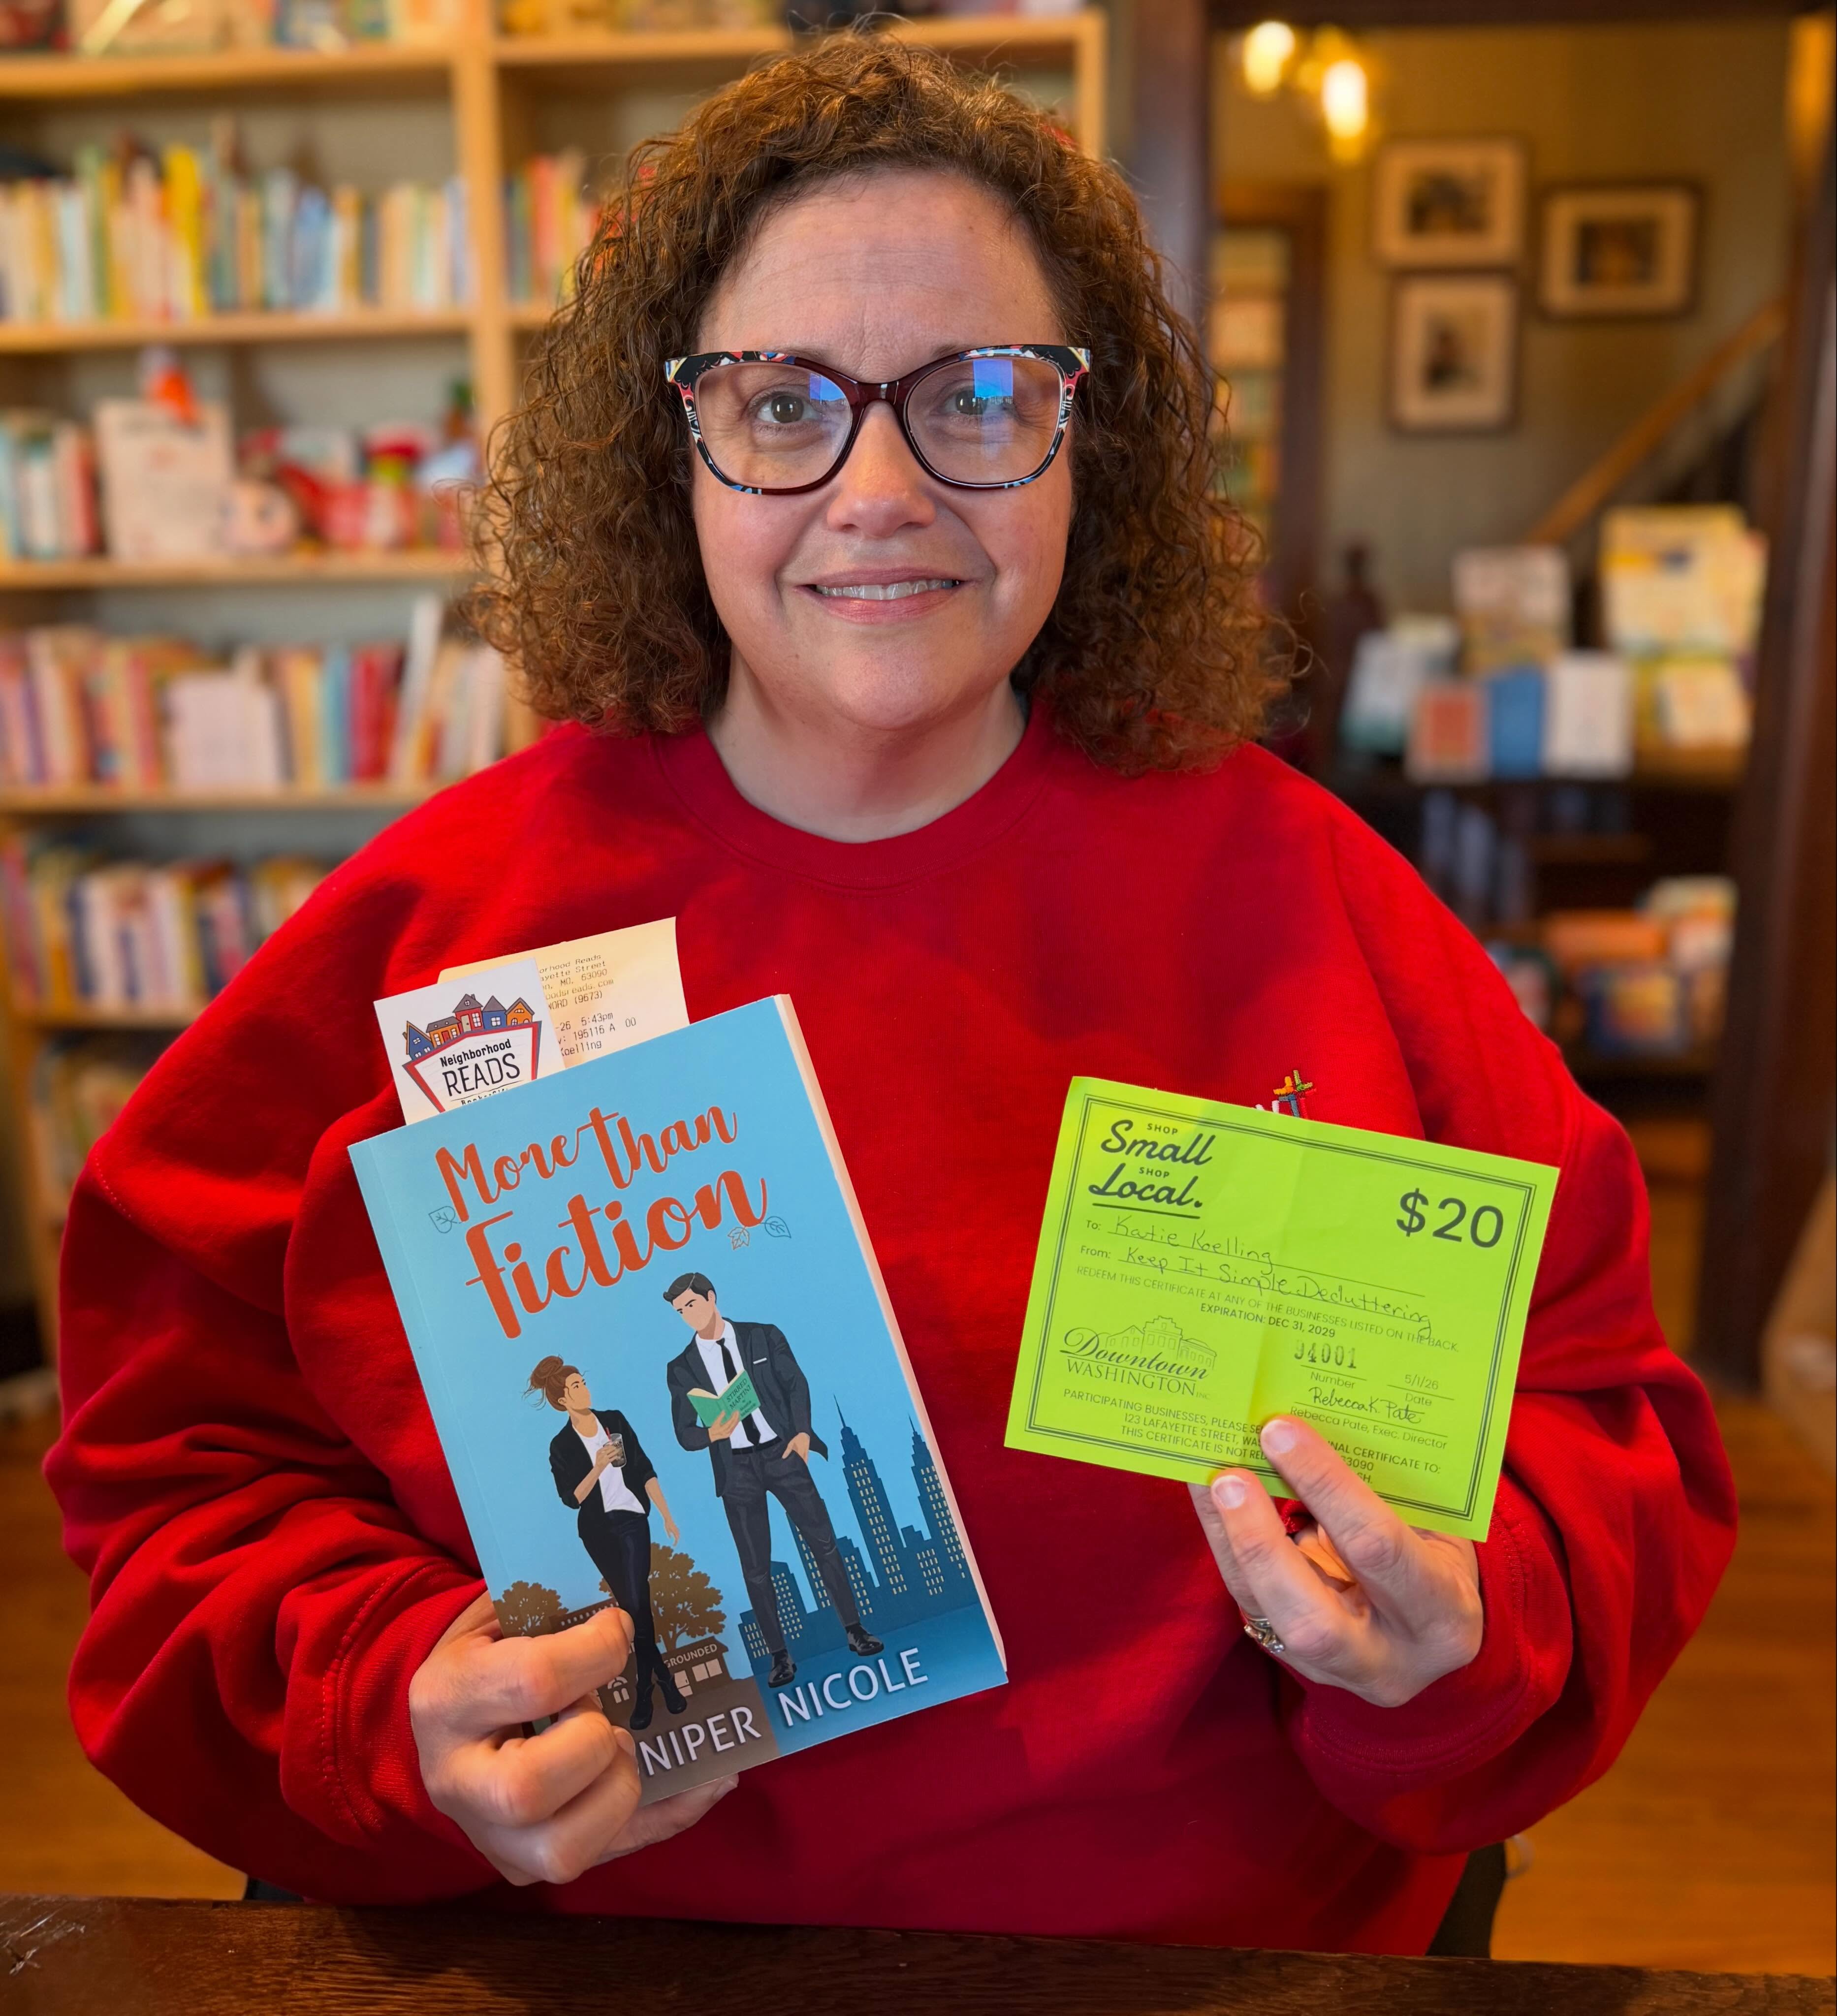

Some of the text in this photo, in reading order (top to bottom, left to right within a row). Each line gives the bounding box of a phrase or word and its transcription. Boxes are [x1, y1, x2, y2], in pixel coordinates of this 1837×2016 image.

[539, 954, 601, 973] orhood Reads
[541, 961, 605, 981] yette Street
[581, 969, 607, 981] 63090
[575, 991, 602, 1004] (9673)
[573, 1025, 604, 1040] 195116
[609, 1023, 615, 1032] A
[581, 1012, 613, 1026] 5:43pm
[440, 1039, 511, 1067] Neighborhood
[442, 1053, 520, 1097] READS
[1101, 1119, 1216, 1166] Small
[1146, 1123, 1178, 1135] SHOP
[435, 1105, 738, 1224] More than
[1139, 1166, 1170, 1178] SHOP
[1088, 1163, 1203, 1208] Local.
[1086, 1220, 1101, 1230] To:
[1396, 1188, 1504, 1248] $20
[465, 1169, 768, 1340] Fiction
[1080, 1245, 1110, 1259] From:
[1115, 1215, 1273, 1275] Katie Koelling
[1077, 1265, 1459, 1352] REDEEM THIS CERTIFICATE AT ANY OF THE BUSINESSES LISTED ON THE BACK.
[1127, 1247, 1431, 1340] Keep It Simple Decluttering
[1201, 1303, 1335, 1338] EXPIRATION: DEC 31, 2029
[1059, 1327, 1210, 1380] Downtown
[1067, 1358, 1196, 1396] WASHINGTON
[1311, 1371, 1356, 1388] Number
[1405, 1374, 1439, 1390] 5/1/26
[1064, 1388, 1263, 1433] PARTICIPATING BUSINESSES, PLEASE SE
[1405, 1393, 1432, 1406] Date
[1121, 1425, 1143, 1438] THIS
[1146, 1430, 1210, 1451] CERTIFICATE
[1213, 1442, 1223, 1453] IS
[1226, 1445, 1247, 1457] NOT
[1124, 1413, 1140, 1424] 123
[1143, 1417, 1197, 1435] LAFAYETTE
[1201, 1429, 1239, 1445] STREET,
[1291, 1406, 1447, 1449] Rebecca Pate, Exec. Director
[1353, 1447, 1421, 1469] CERTIFICATE
[1424, 1463, 1441, 1476] TO:
[664, 1644, 717, 1668] GROUNDED
[638, 1647, 929, 1776] NIPER NICOLE
